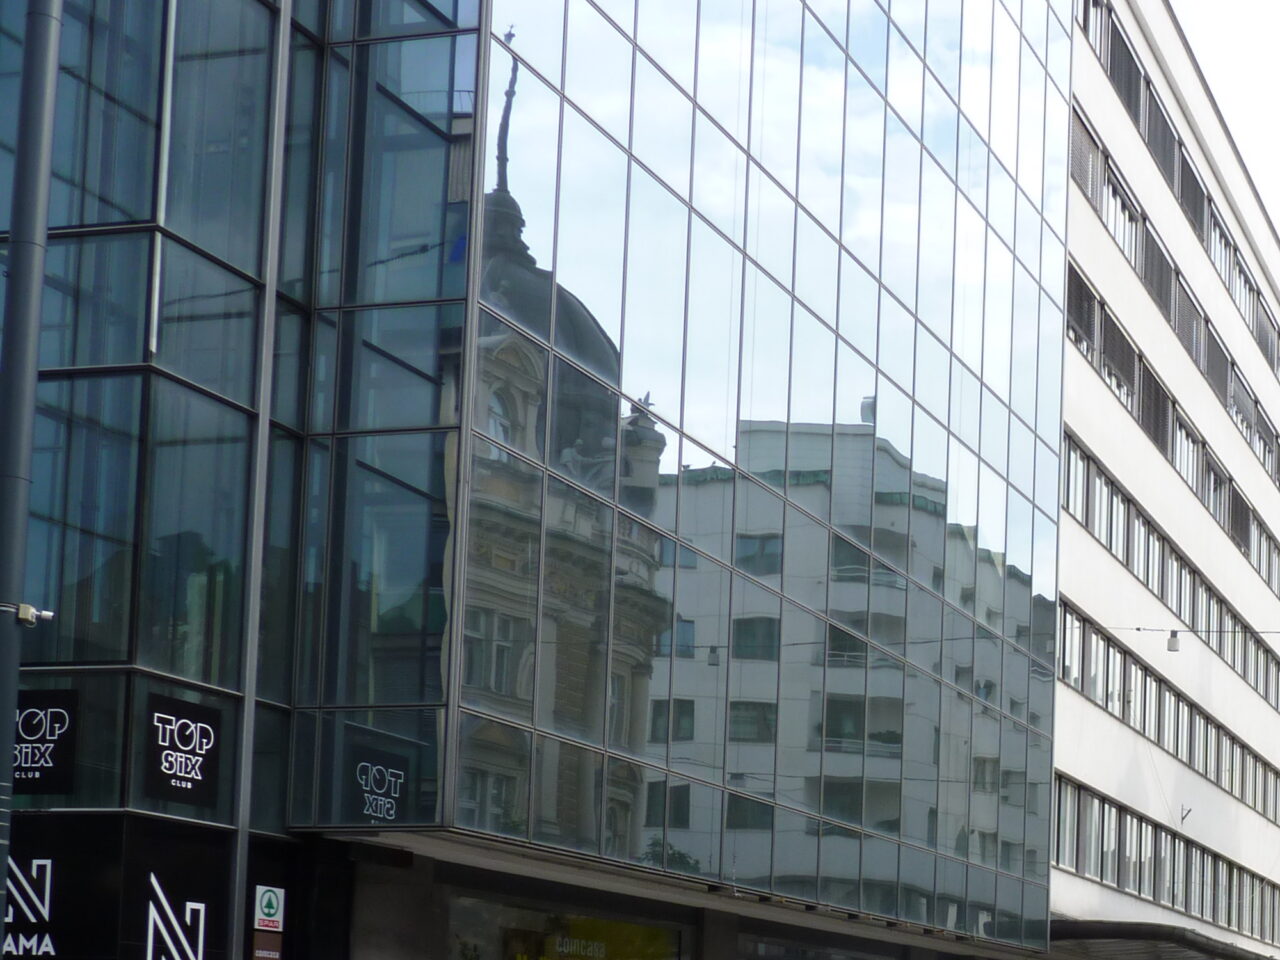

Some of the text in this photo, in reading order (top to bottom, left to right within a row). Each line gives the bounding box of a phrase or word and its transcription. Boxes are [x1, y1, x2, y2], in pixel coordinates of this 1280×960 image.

[16, 708, 69, 740] OP
[154, 712, 214, 754] TOP
[171, 779, 193, 789] CLUB
[259, 919, 280, 928] SPAR
[2, 933, 56, 955] AMA
